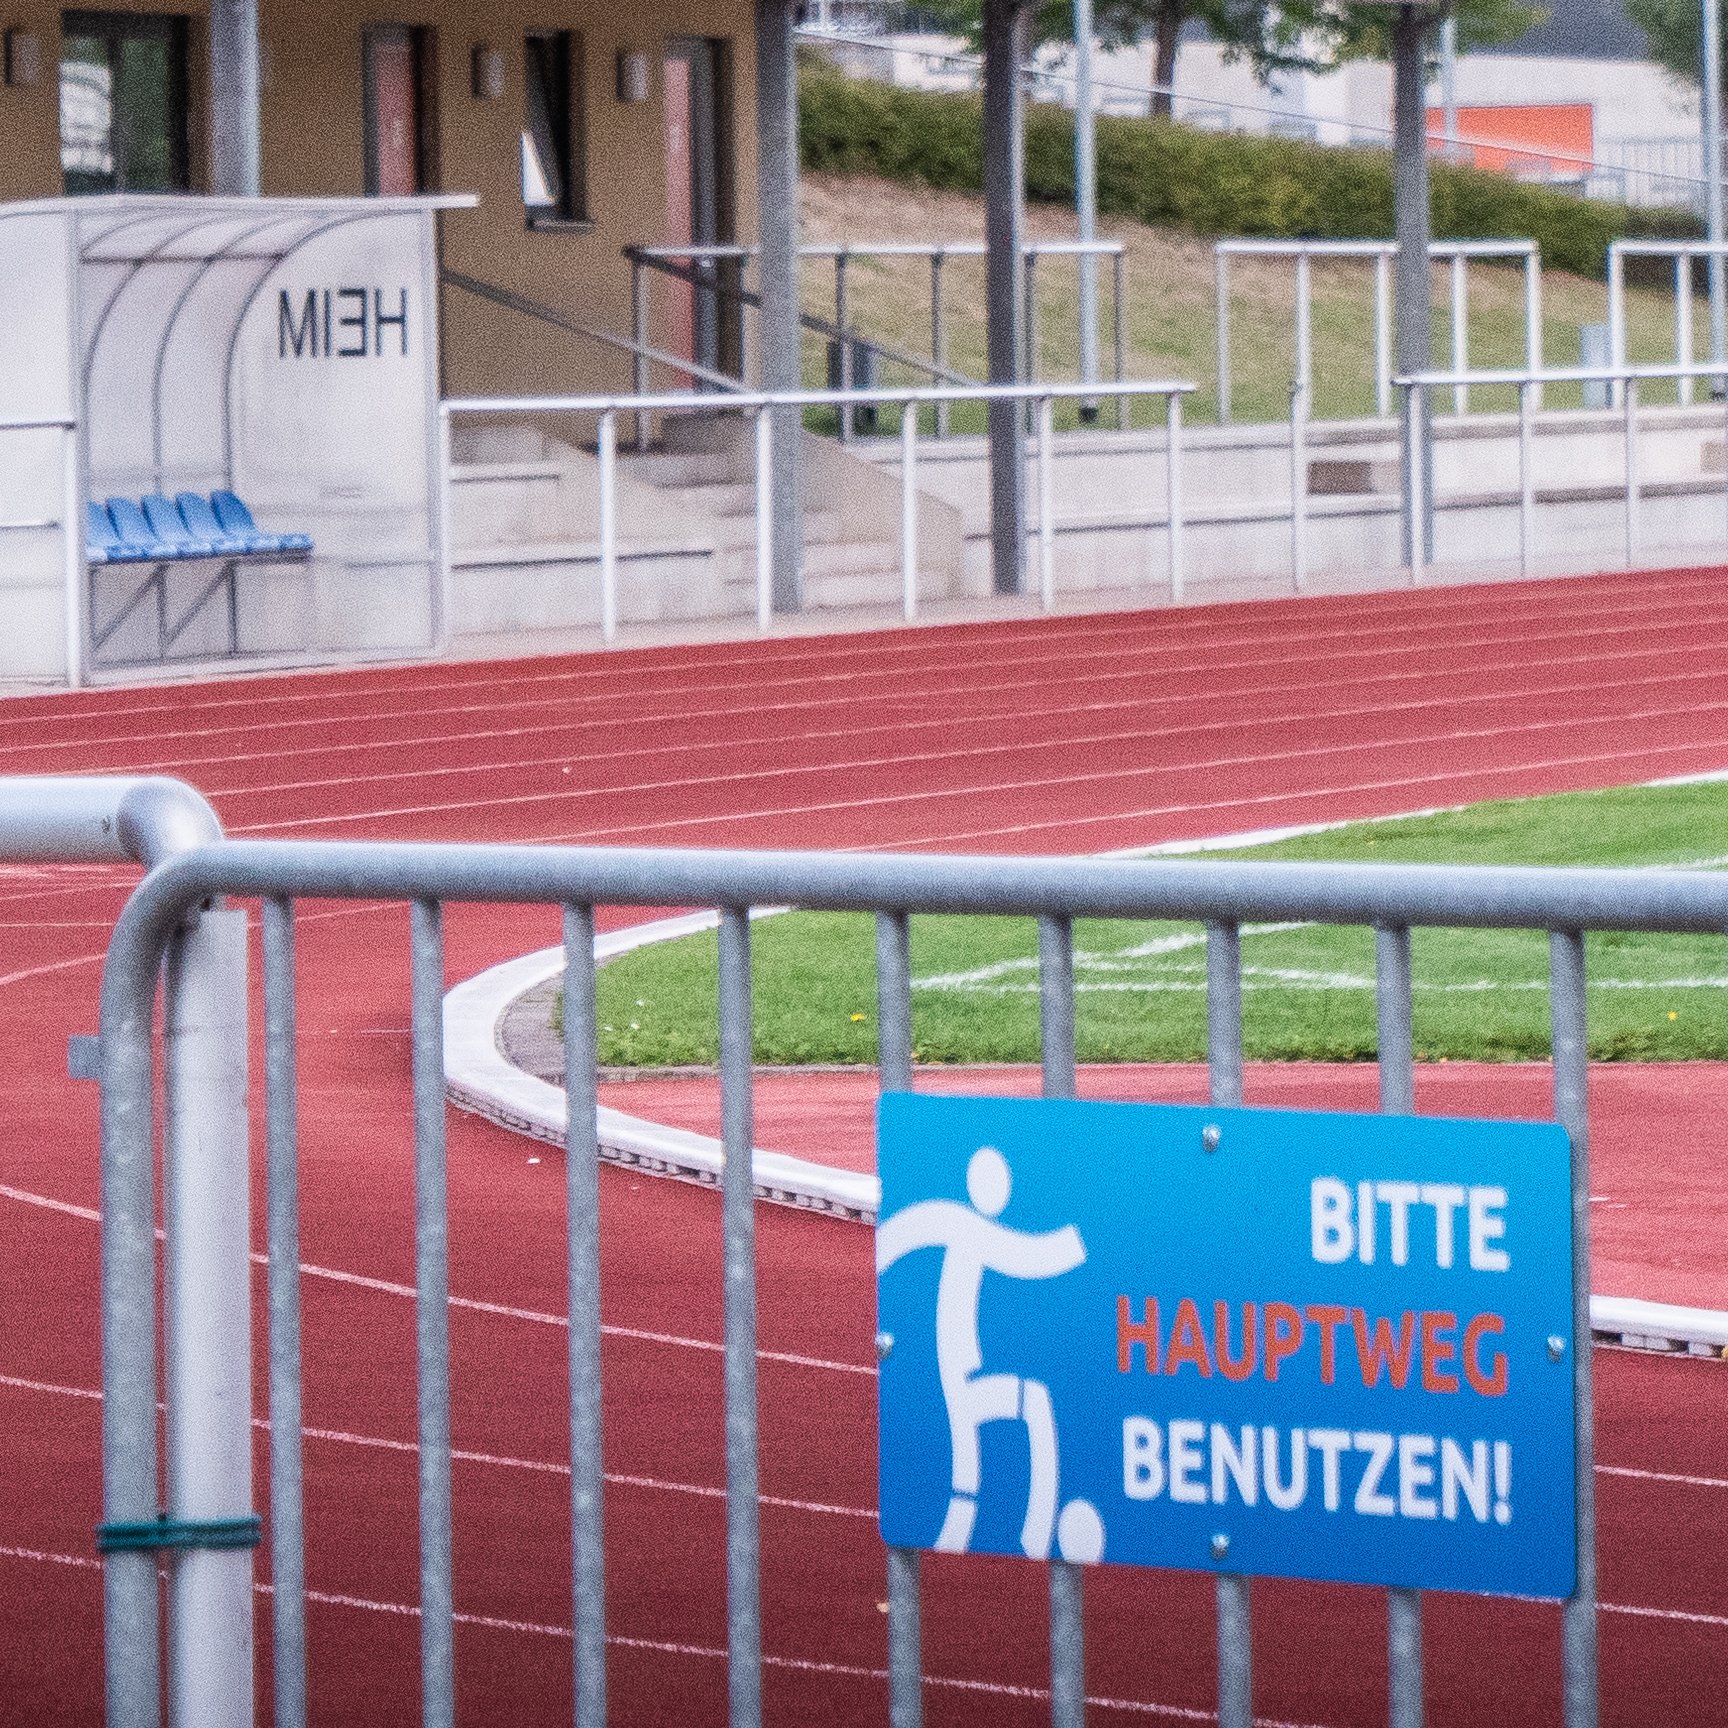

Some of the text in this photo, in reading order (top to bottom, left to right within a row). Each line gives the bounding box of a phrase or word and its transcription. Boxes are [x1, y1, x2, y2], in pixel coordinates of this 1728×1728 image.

[1310, 1176, 1511, 1272] BITTE
[1116, 1294, 1509, 1397] HAUPTWEG
[1122, 1415, 1512, 1525] BENUTZEN!
